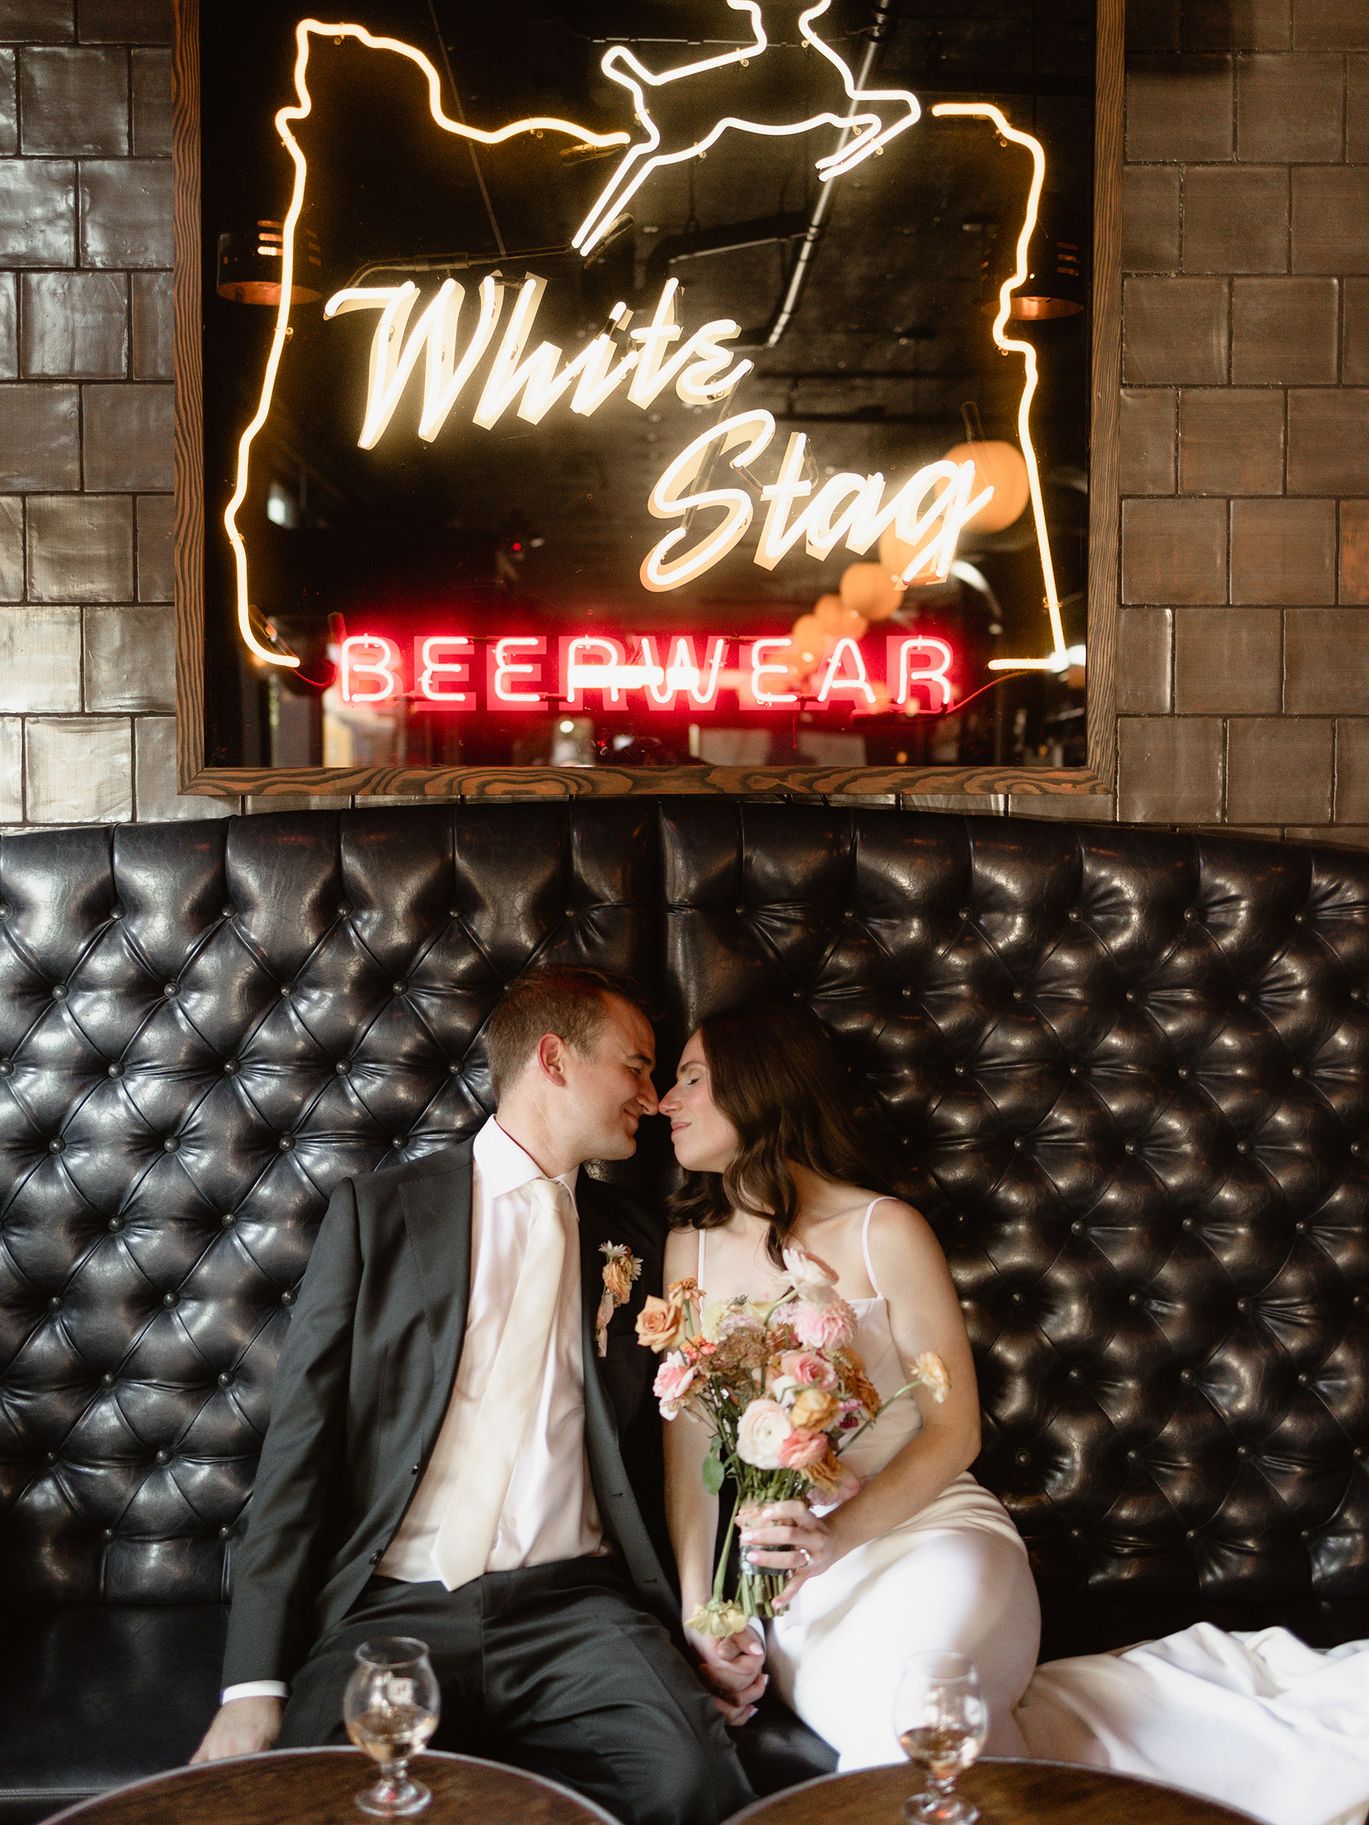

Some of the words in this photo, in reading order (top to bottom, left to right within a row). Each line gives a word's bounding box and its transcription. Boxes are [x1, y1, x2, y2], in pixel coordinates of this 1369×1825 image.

[324, 272, 754, 451] White
[639, 408, 995, 592] Stag
[338, 634, 956, 711] BEERWEAR
